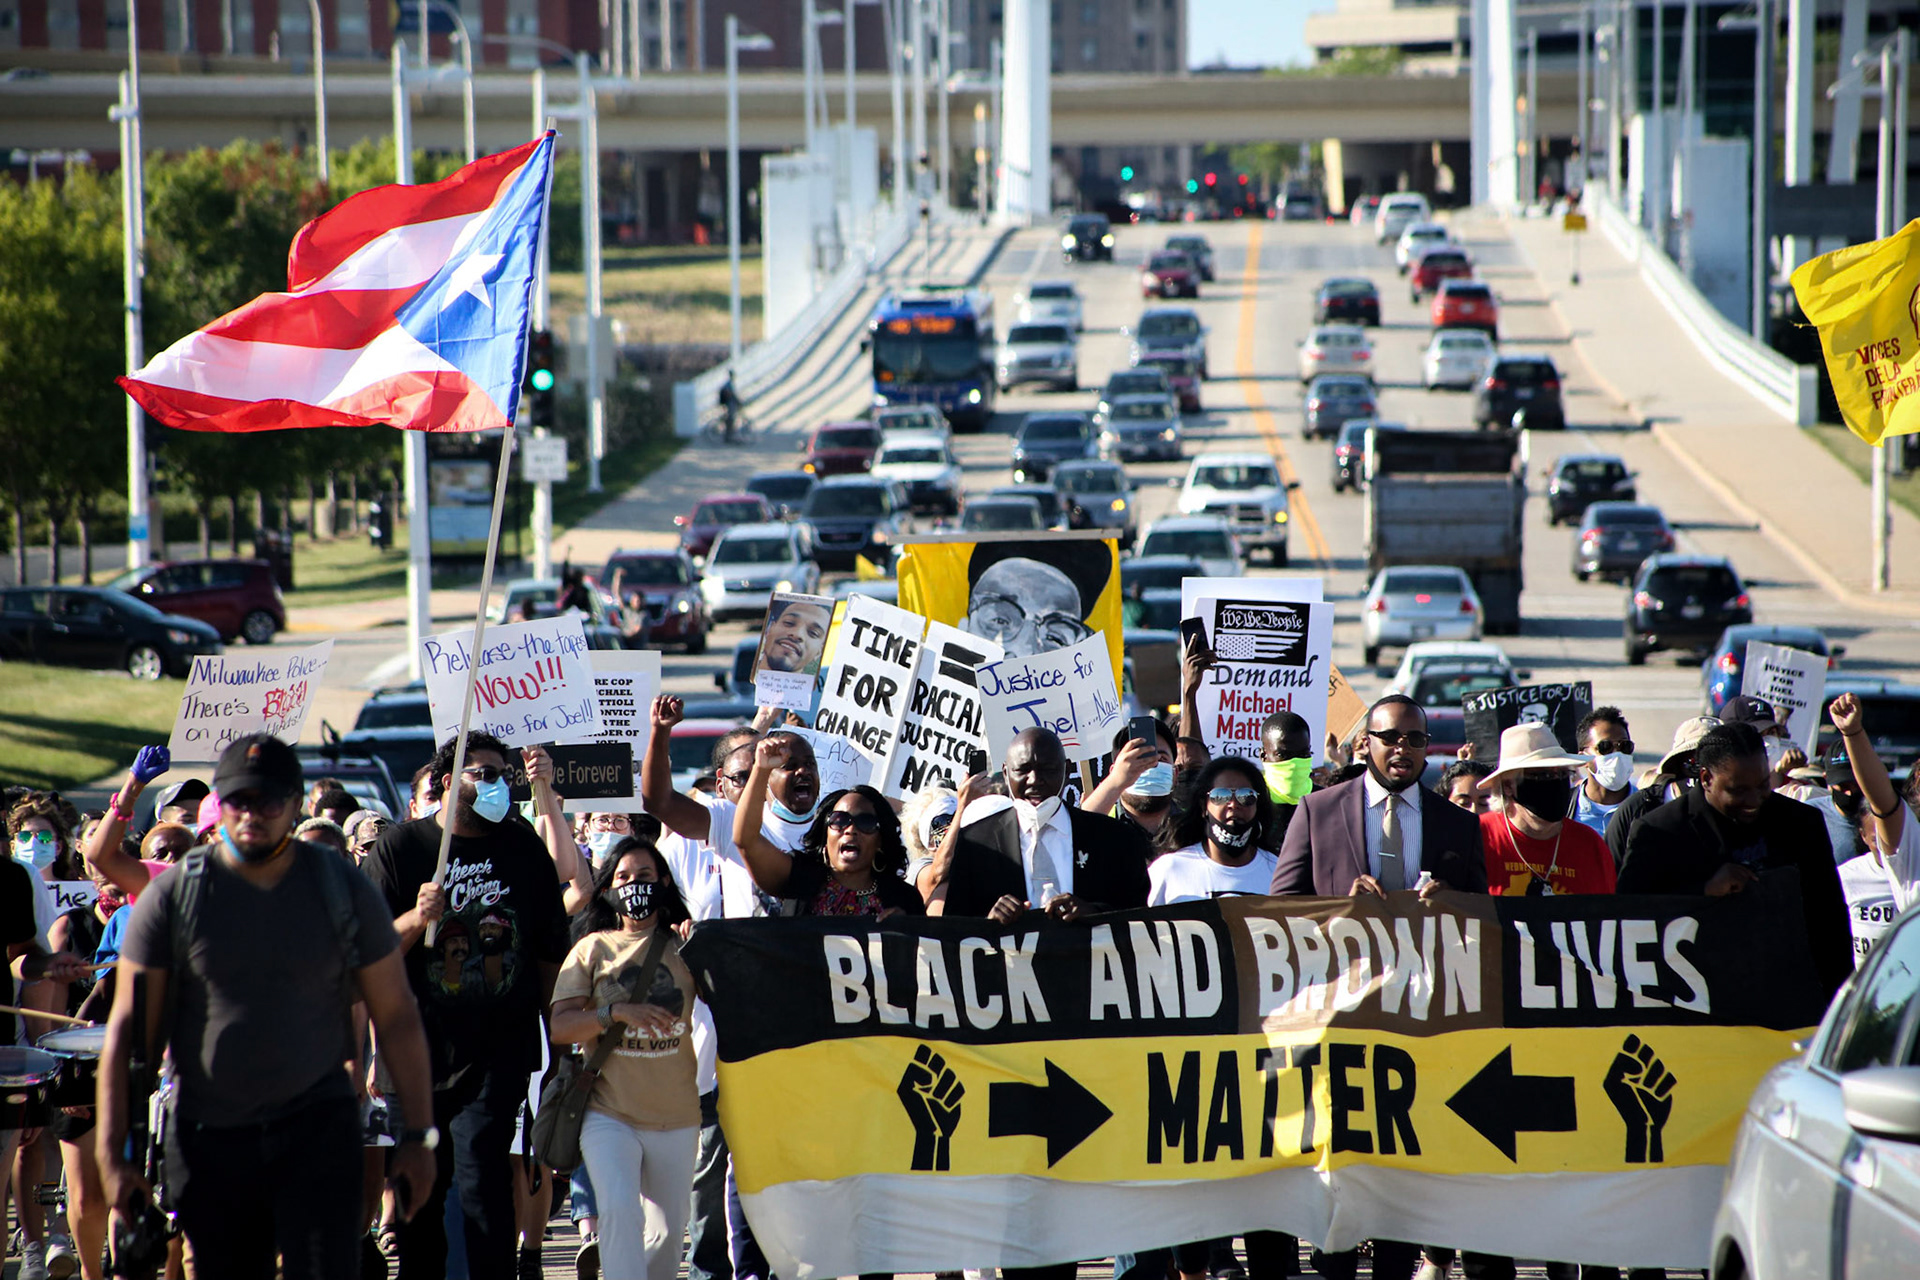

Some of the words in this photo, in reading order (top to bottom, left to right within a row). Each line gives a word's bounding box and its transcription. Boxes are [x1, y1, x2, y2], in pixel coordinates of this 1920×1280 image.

[1856, 337, 1901, 365] VOCES
[1865, 367, 1885, 388] DE
[1884, 362, 1901, 382] LA
[1260, 611, 1304, 631] People
[517, 633, 555, 658] the
[851, 617, 917, 669] TIME
[191, 658, 281, 686] Milwaukee
[594, 678, 608, 686] RE
[611, 678, 633, 686] COP
[977, 661, 1066, 696] Justice
[1074, 652, 1094, 679] for
[1209, 654, 1319, 688] Demand
[1764, 663, 1805, 678] JUSTICE
[1772, 675, 1793, 686] FOR
[474, 656, 567, 713] NOW!!!
[597, 688, 633, 696] CHAEL
[836, 664, 898, 718] FOR
[1770, 684, 1794, 696] JOEL
[182, 690, 250, 719] There's
[910, 678, 983, 737] RACIAL
[1219, 689, 1292, 714] Michael
[185, 727, 209, 741] on
[522, 714, 548, 733] for
[625, 729, 640, 737] OF
[815, 708, 892, 757] CHANGE
[1216, 714, 1266, 741] Matt
[801, 733, 862, 777] LACK
[899, 721, 978, 766] JUSTICE
[568, 760, 622, 784] Forever
[450, 879, 511, 913] Chong
[823, 931, 1051, 1030] BLACK
[1089, 919, 1223, 1021] AND
[1244, 913, 1481, 1022] BROWN
[1513, 915, 1711, 1014] LIVES
[627, 1039, 644, 1050] EL
[649, 1037, 680, 1051] VOTO
[1147, 1042, 1421, 1164] MATTER
